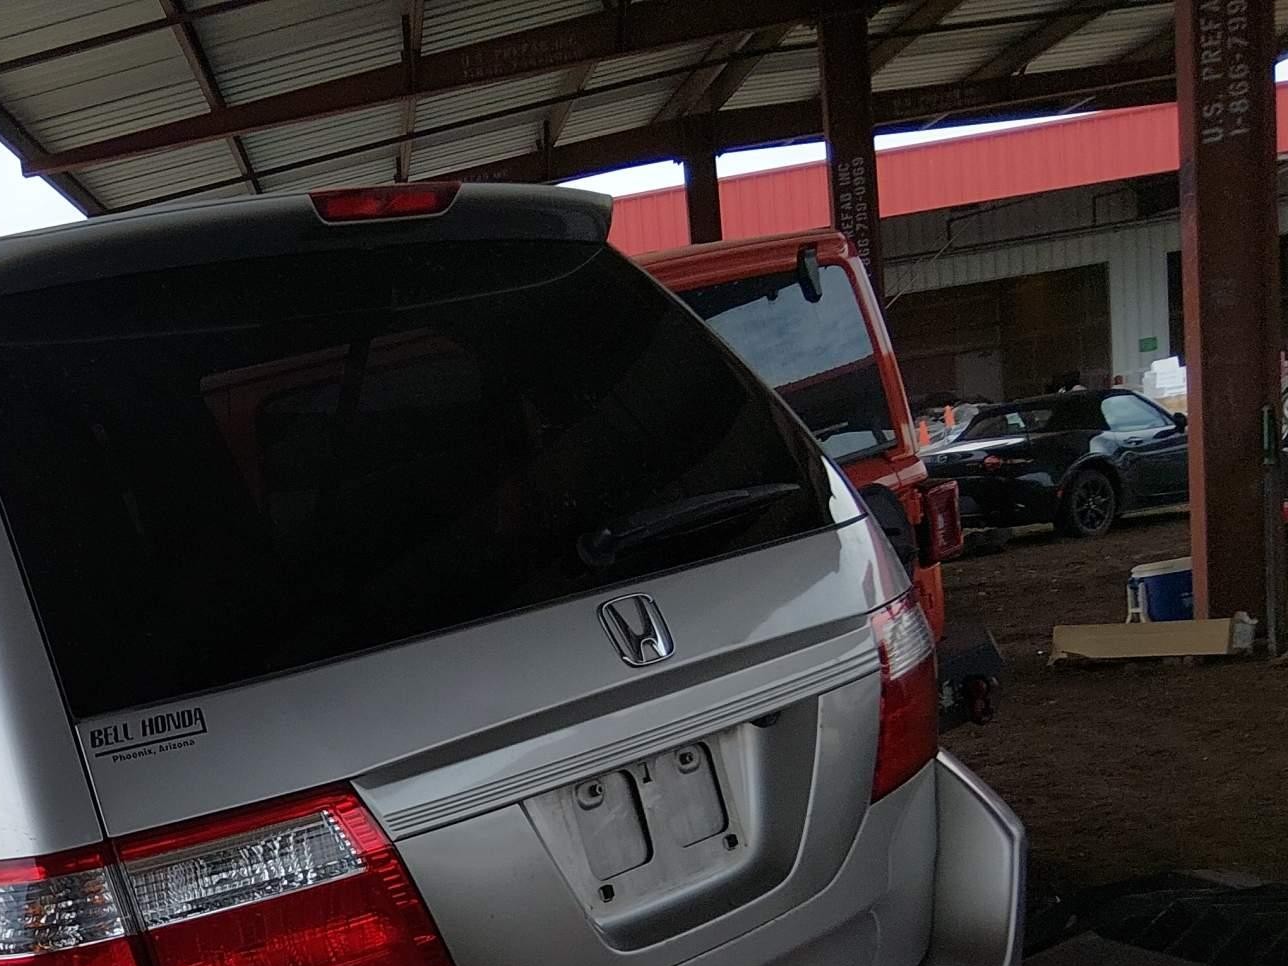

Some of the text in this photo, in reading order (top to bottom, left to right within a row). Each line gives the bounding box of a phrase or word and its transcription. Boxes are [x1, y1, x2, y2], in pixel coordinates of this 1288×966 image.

[90, 707, 207, 748] BELL HONDA
[112, 739, 196, 763] Phoenix, Arizona
